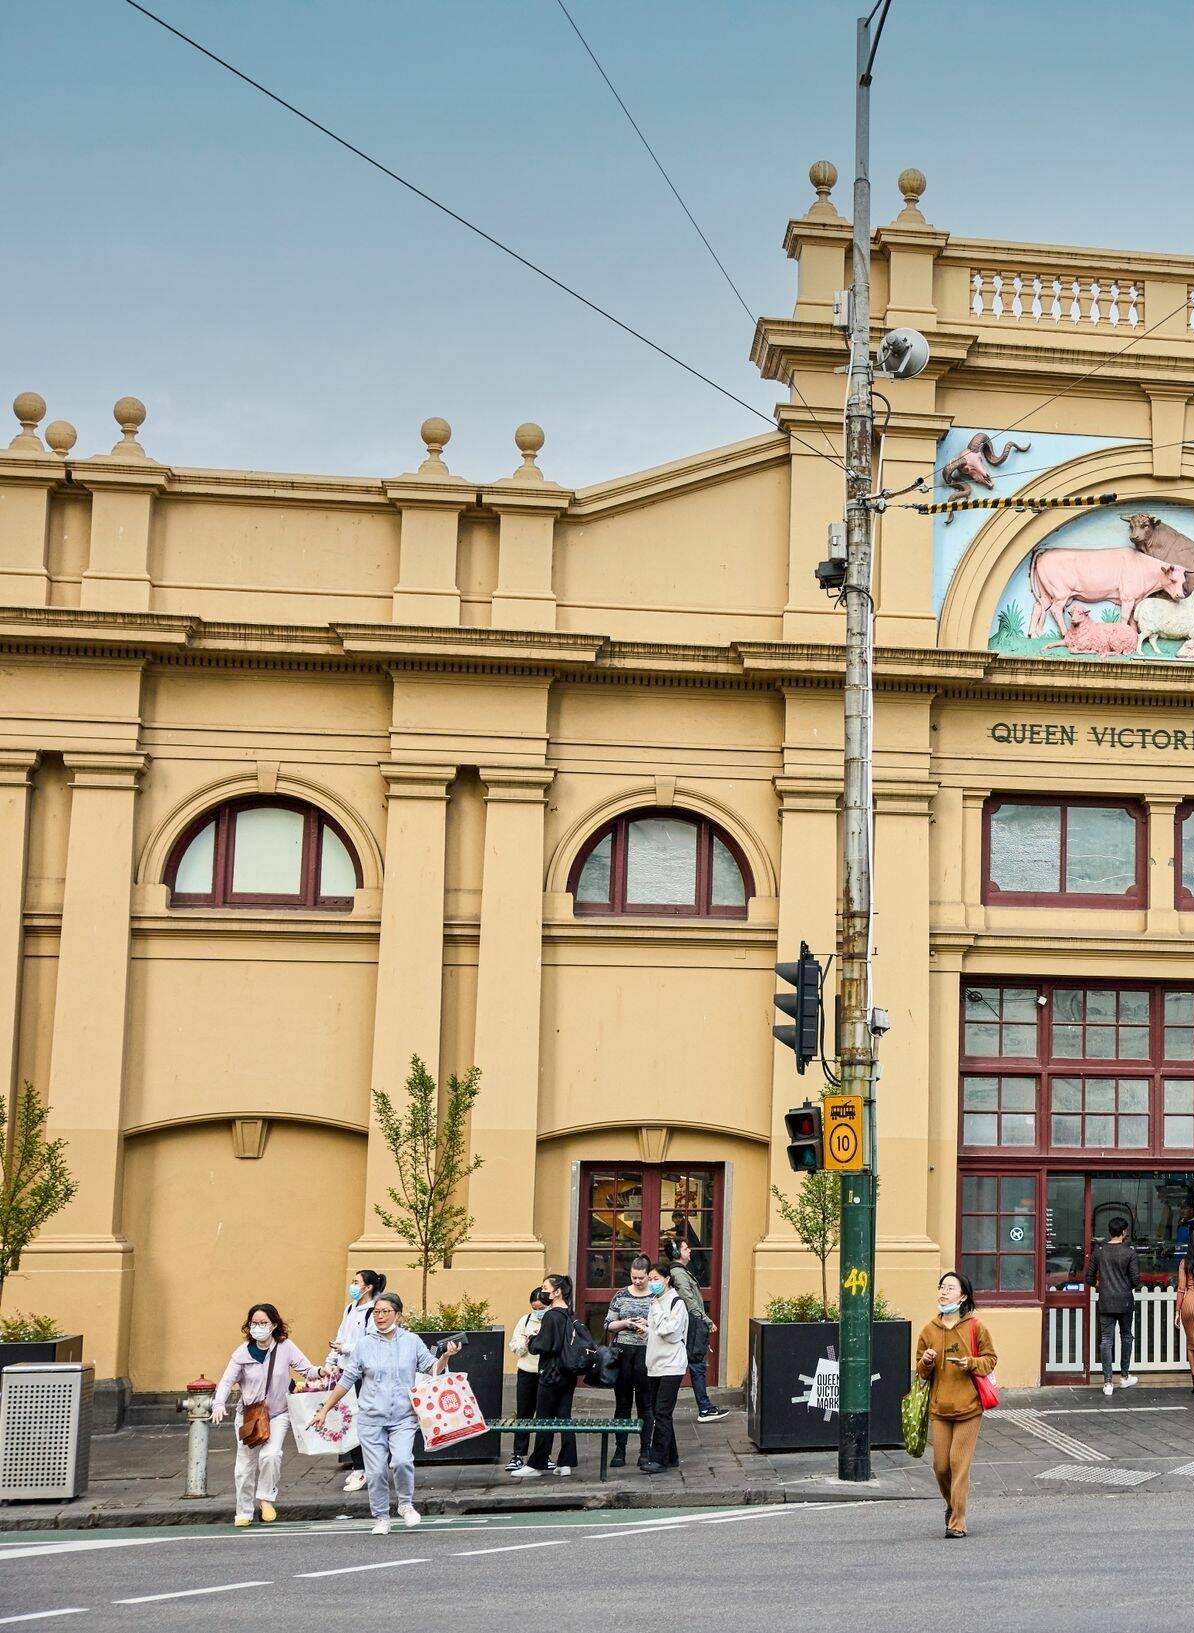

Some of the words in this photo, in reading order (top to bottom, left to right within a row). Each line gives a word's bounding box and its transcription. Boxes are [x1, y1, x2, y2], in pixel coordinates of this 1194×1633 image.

[991, 722, 1075, 746] QUEEN
[837, 1135, 850, 1152] 10
[817, 1386, 839, 1397] VICTO
[817, 1398, 839, 1409] MARK
